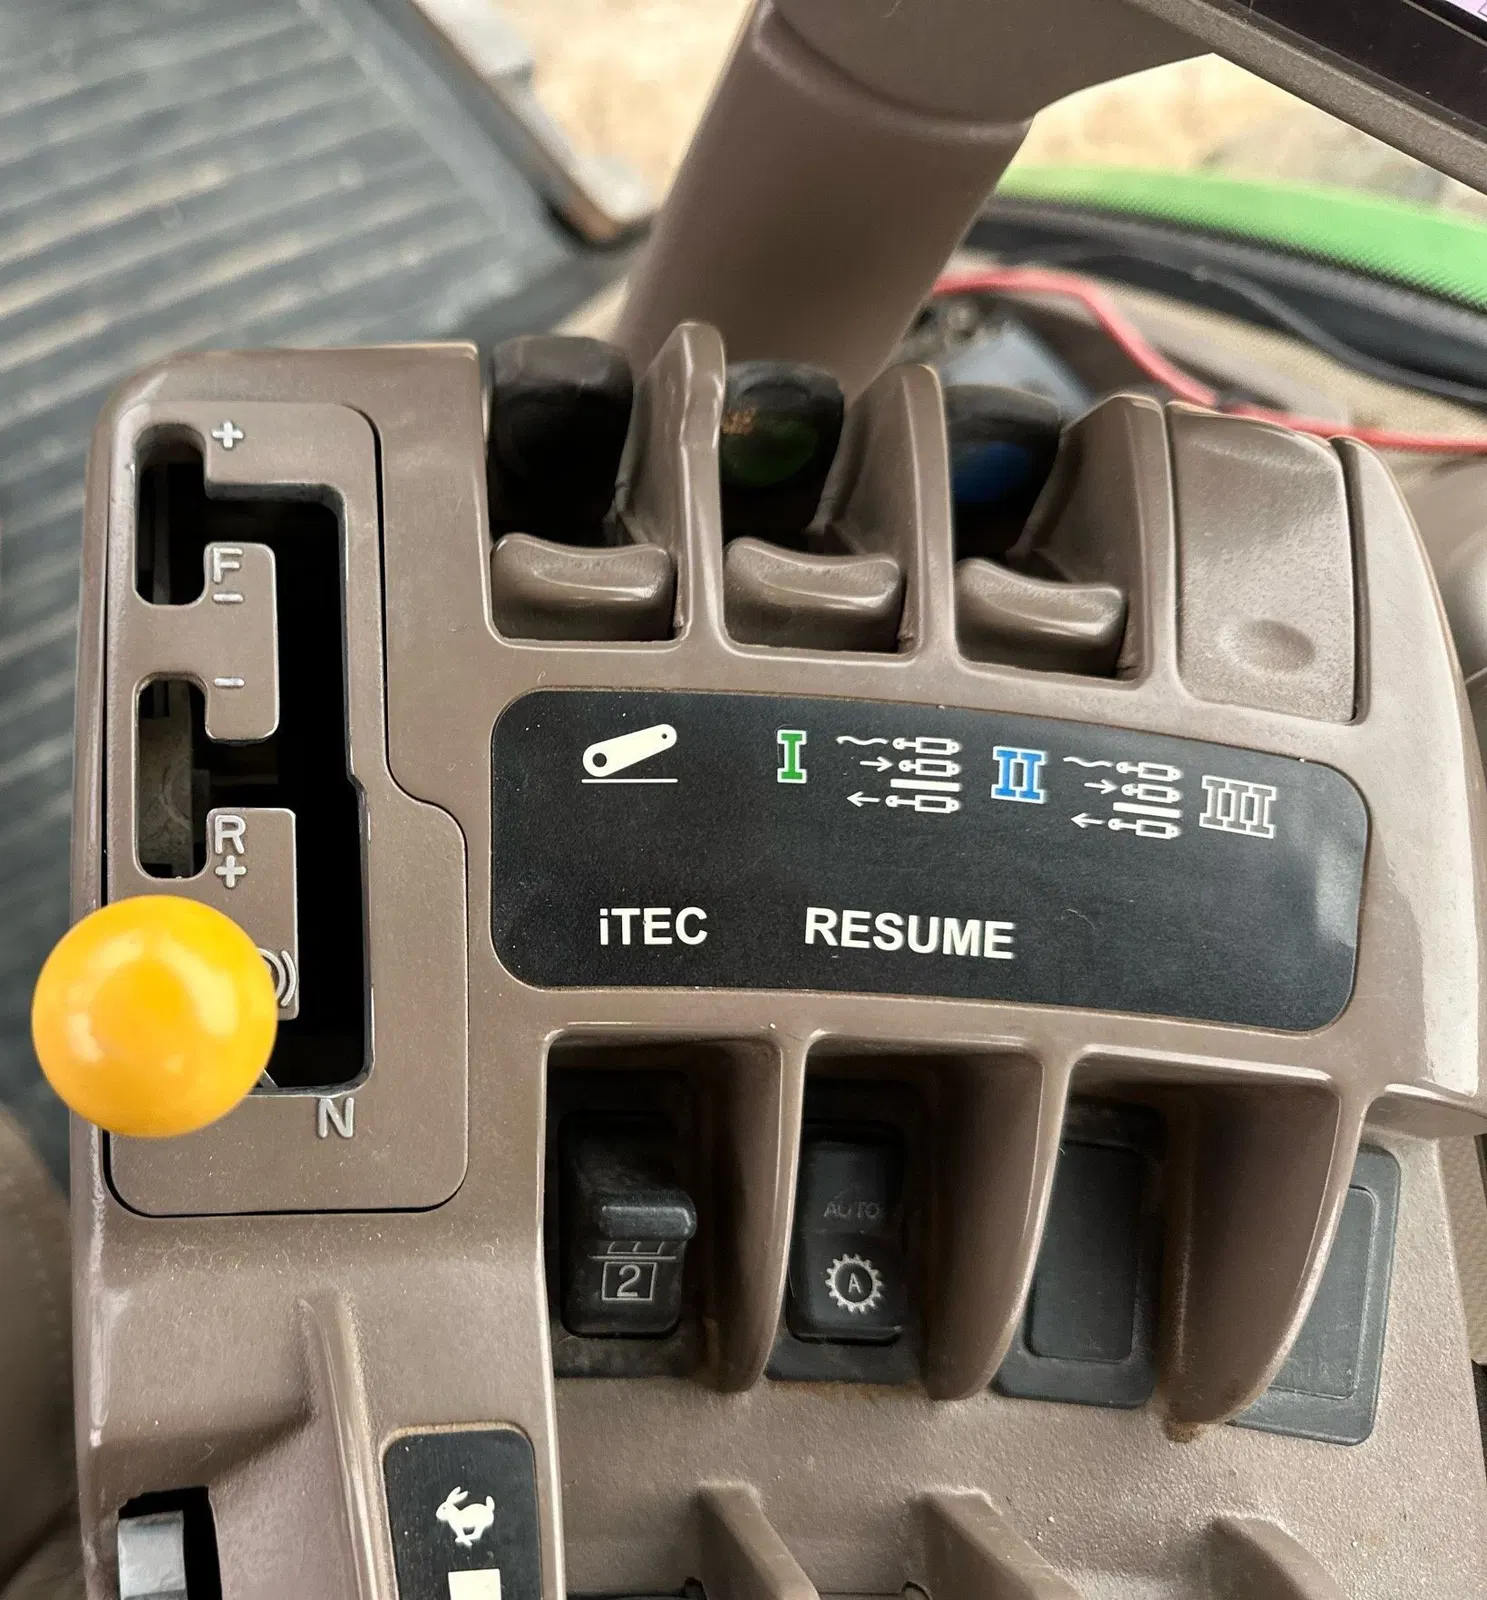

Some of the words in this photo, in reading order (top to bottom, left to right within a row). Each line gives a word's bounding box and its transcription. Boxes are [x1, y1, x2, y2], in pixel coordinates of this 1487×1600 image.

[212, 548, 243, 583] F
[777, 730, 807, 784] I
[991, 746, 1048, 804] II
[1199, 775, 1277, 839] III
[214, 815, 246, 854] R
[599, 907, 708, 946] iTEC
[804, 907, 1016, 961] RESUME
[317, 1097, 355, 1138] N
[822, 1202, 880, 1222] AUTO
[616, 1264, 643, 1297] 2
